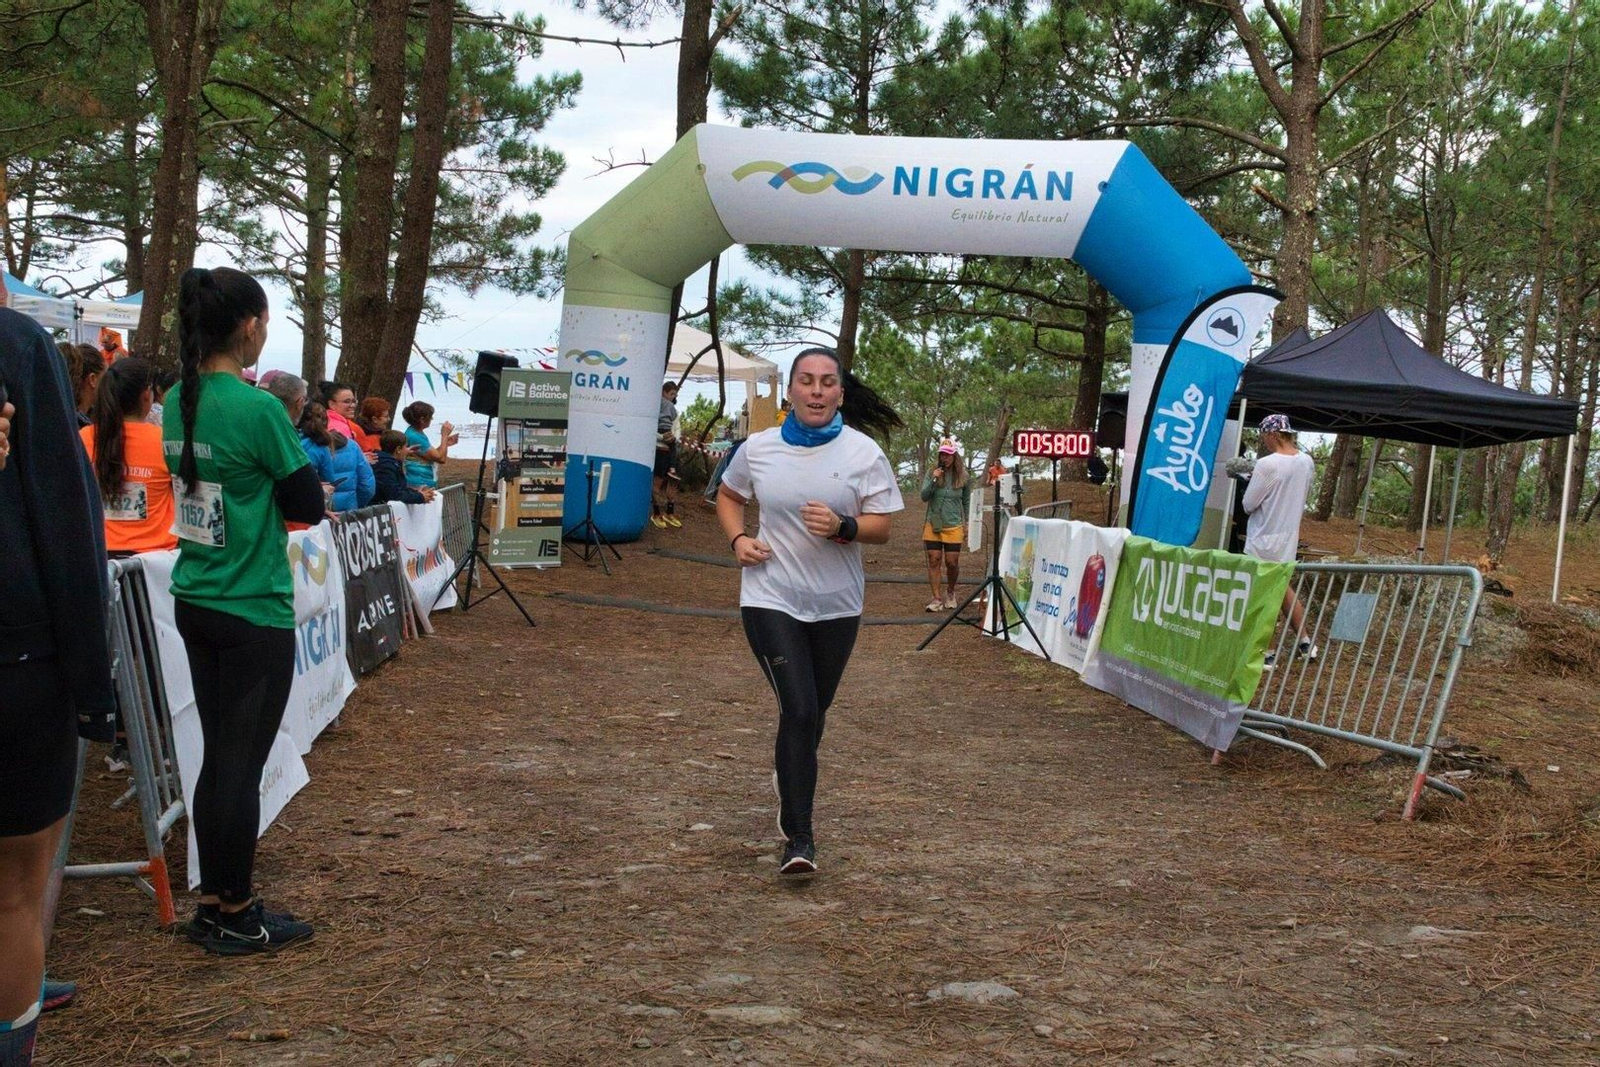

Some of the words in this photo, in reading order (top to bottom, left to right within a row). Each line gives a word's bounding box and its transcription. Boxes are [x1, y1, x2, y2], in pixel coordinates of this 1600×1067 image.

[893, 163, 1073, 202] NIGRÁN
[951, 208, 1012, 224] Equilibrio
[1016, 209, 1069, 224] Natural
[529, 382, 560, 392] Active
[529, 389, 568, 399] Balance
[181, 503, 205, 529] 1152
